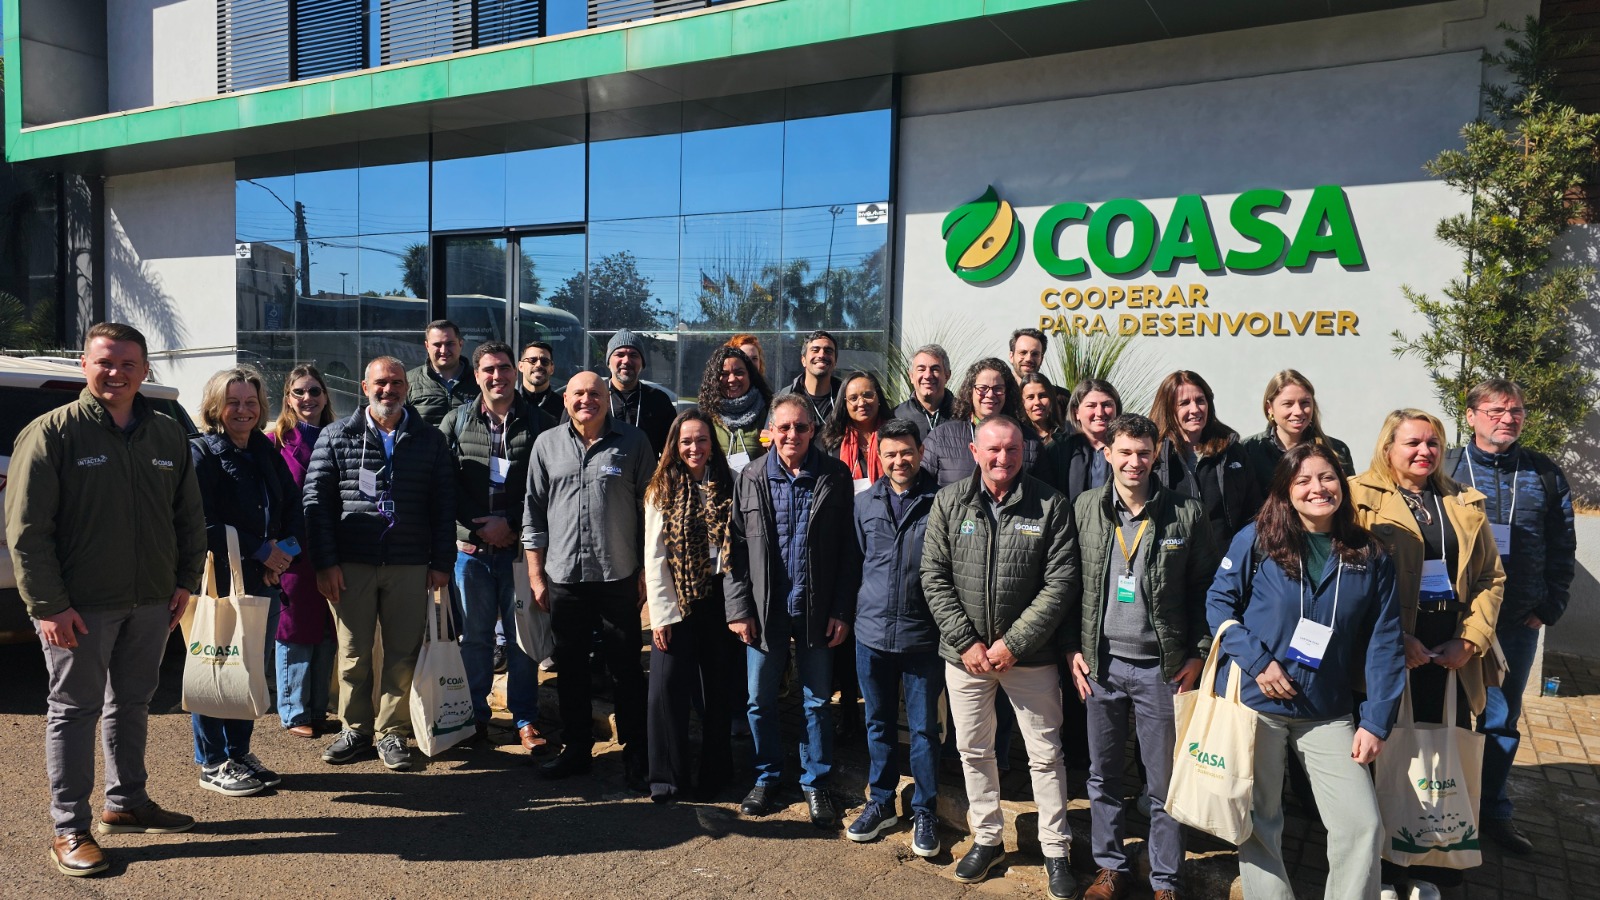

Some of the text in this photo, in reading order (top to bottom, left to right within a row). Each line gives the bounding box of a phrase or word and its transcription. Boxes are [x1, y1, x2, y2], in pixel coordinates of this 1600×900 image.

[1033, 185, 1364, 277] COASA
[1041, 284, 1208, 309] COOPERAR
[1039, 310, 1359, 336] PARA DESENVOLVER
[203, 644, 240, 656] COASA
